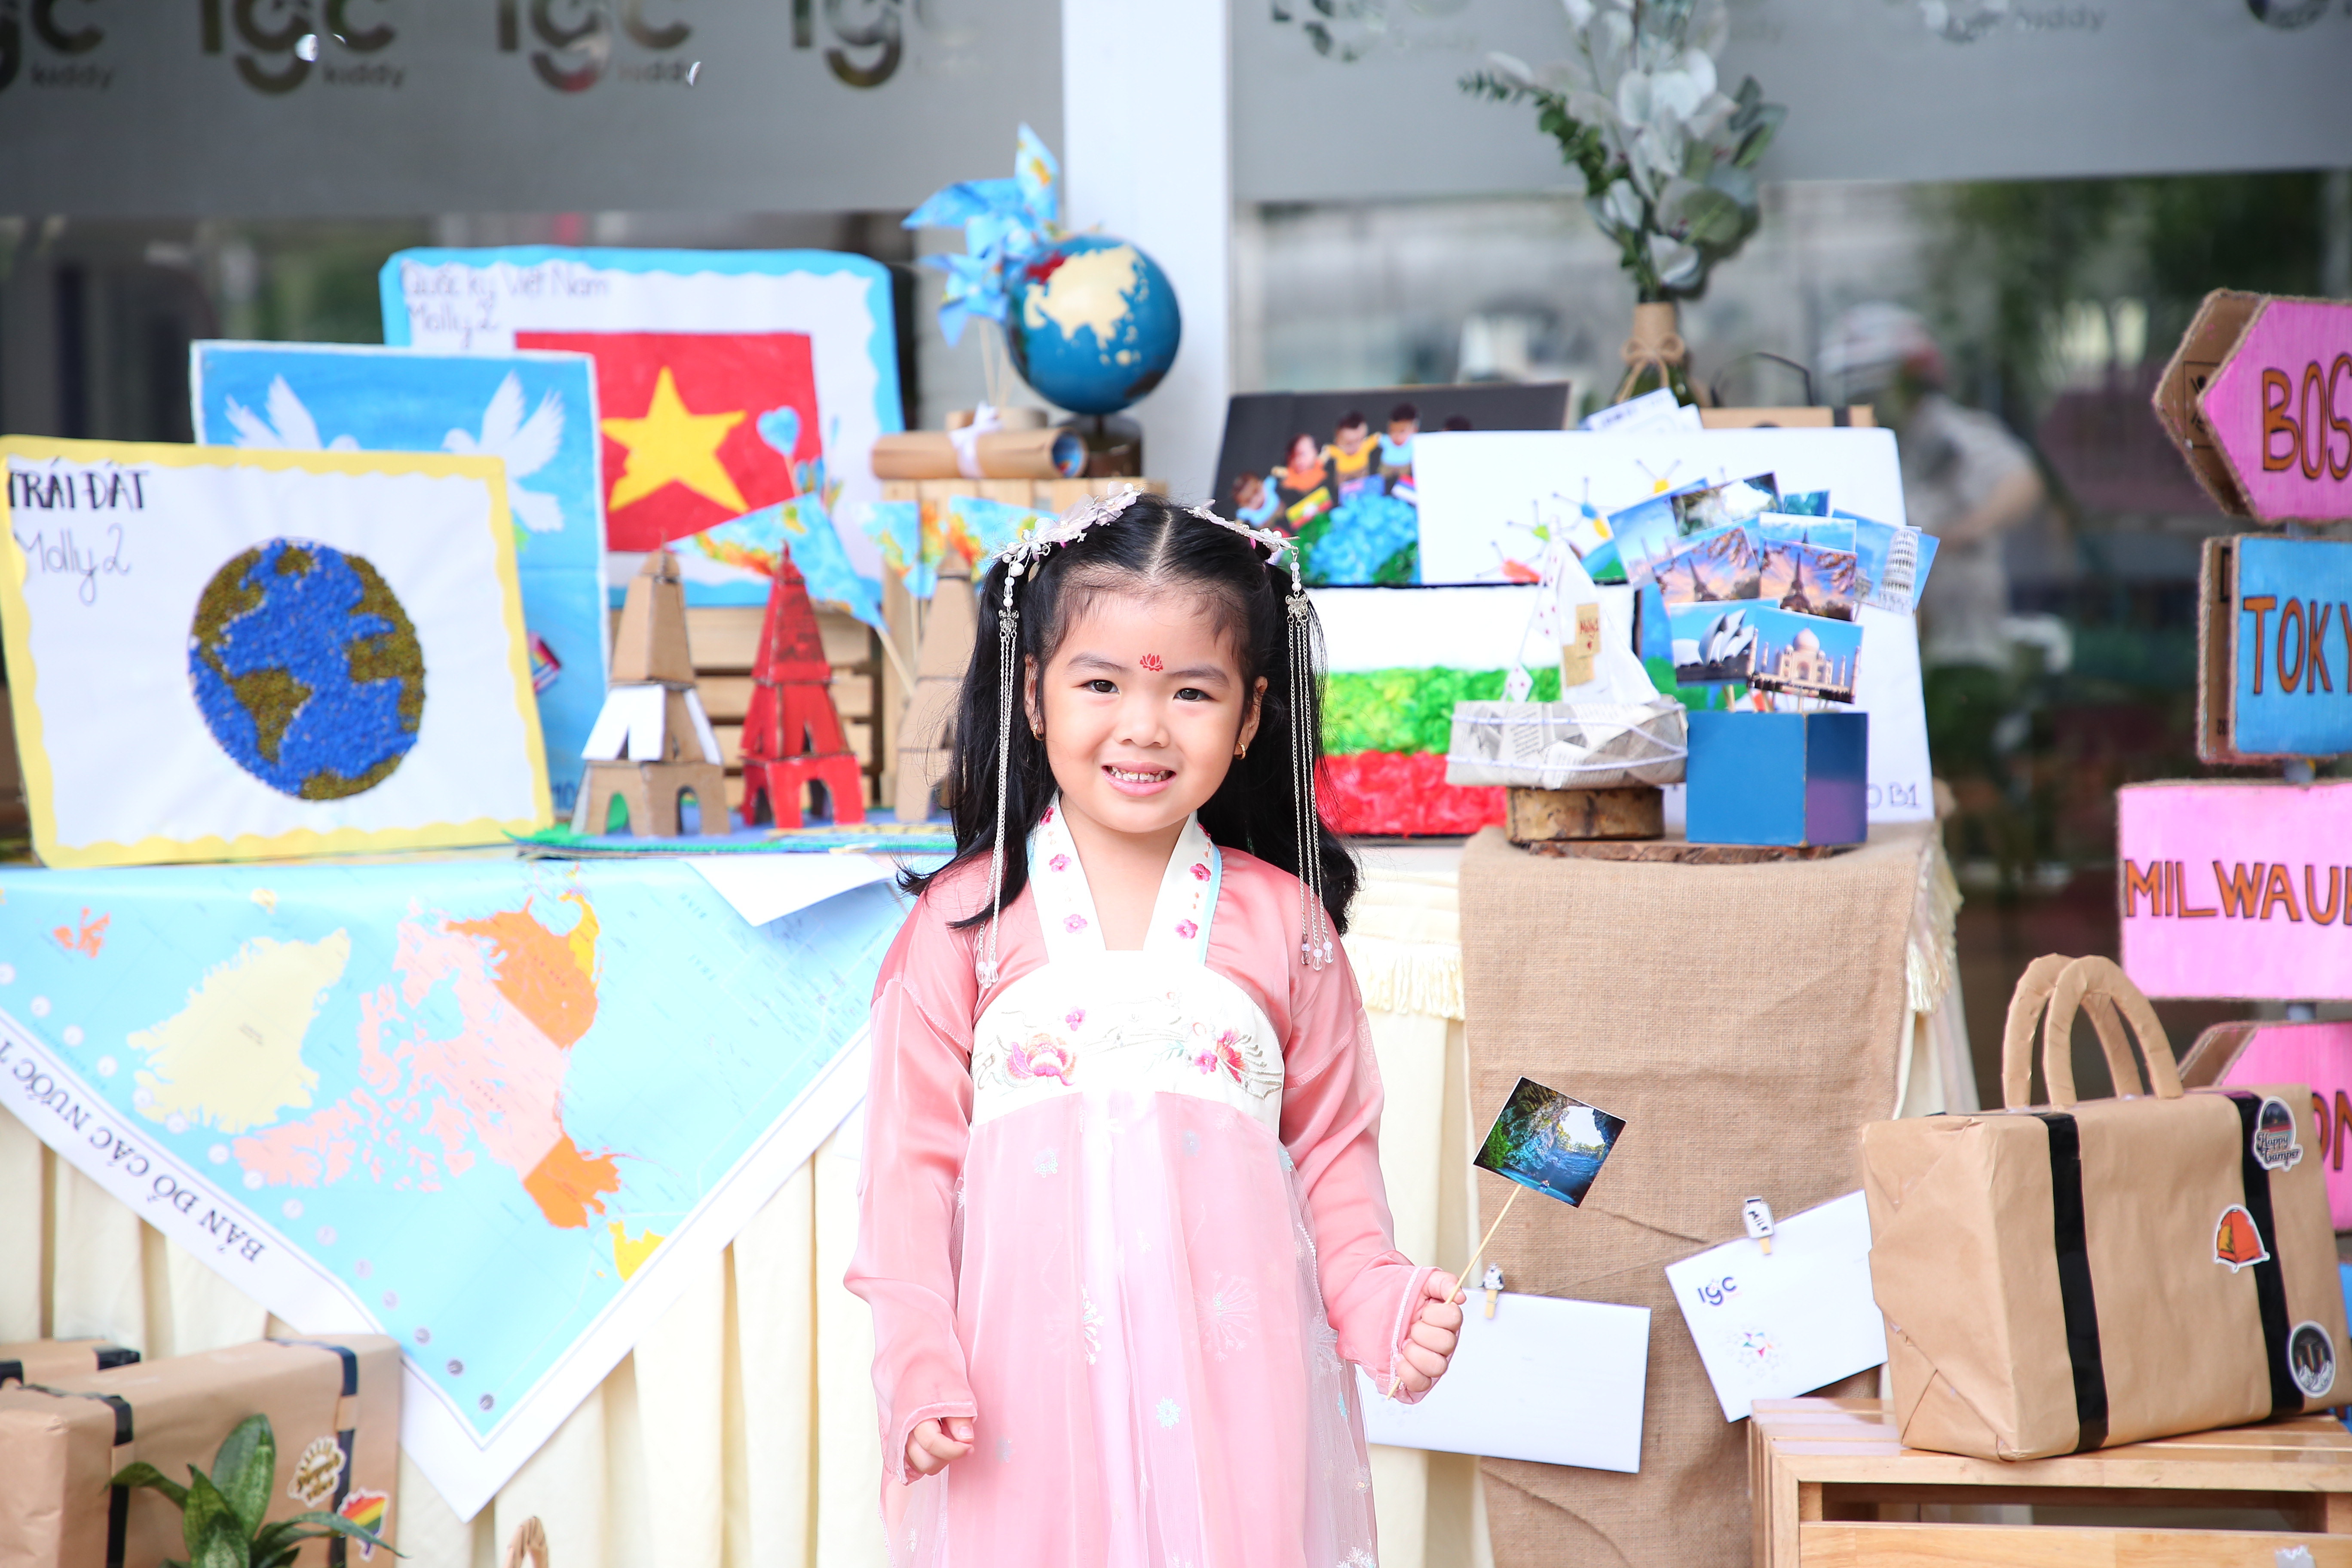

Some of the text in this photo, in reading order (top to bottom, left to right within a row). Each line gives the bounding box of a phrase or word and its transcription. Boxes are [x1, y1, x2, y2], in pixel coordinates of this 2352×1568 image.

[551, 260, 609, 297] Nam
[2262, 352, 2352, 480] BOS
[13, 522, 130, 606] Molly 2
[1748, 1210, 1770, 1233] MILK
